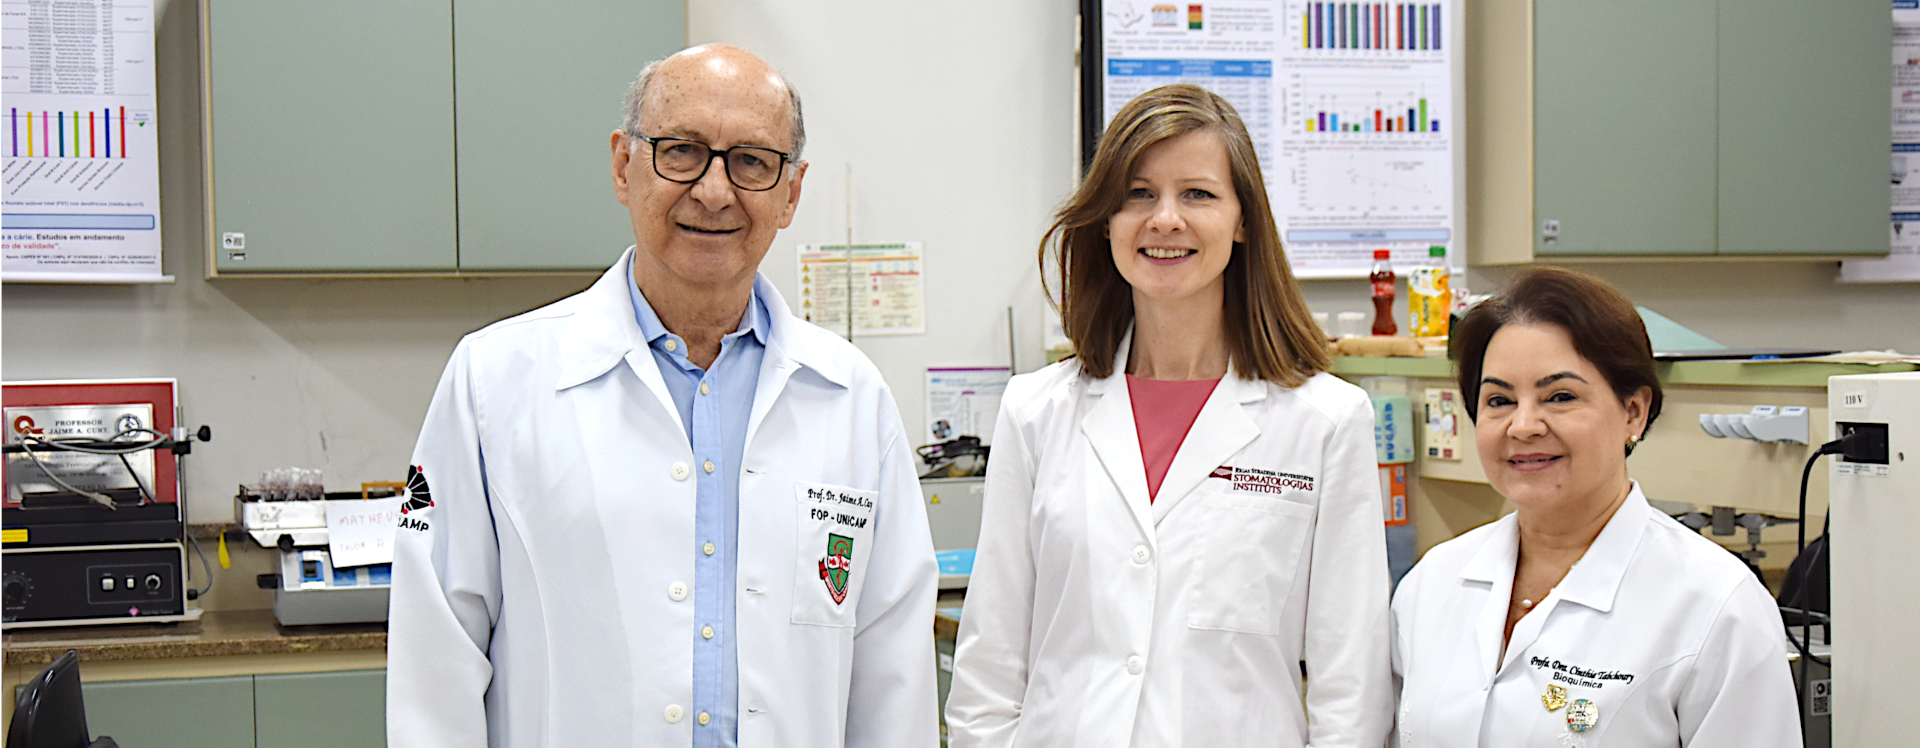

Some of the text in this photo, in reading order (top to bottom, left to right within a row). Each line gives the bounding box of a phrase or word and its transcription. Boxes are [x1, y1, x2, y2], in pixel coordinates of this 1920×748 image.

[1845, 394, 1864, 405] 110 V
[48, 427, 73, 435] JAIME
[811, 508, 829, 521] FOP
[1553, 671, 1603, 688] Bioquímica
